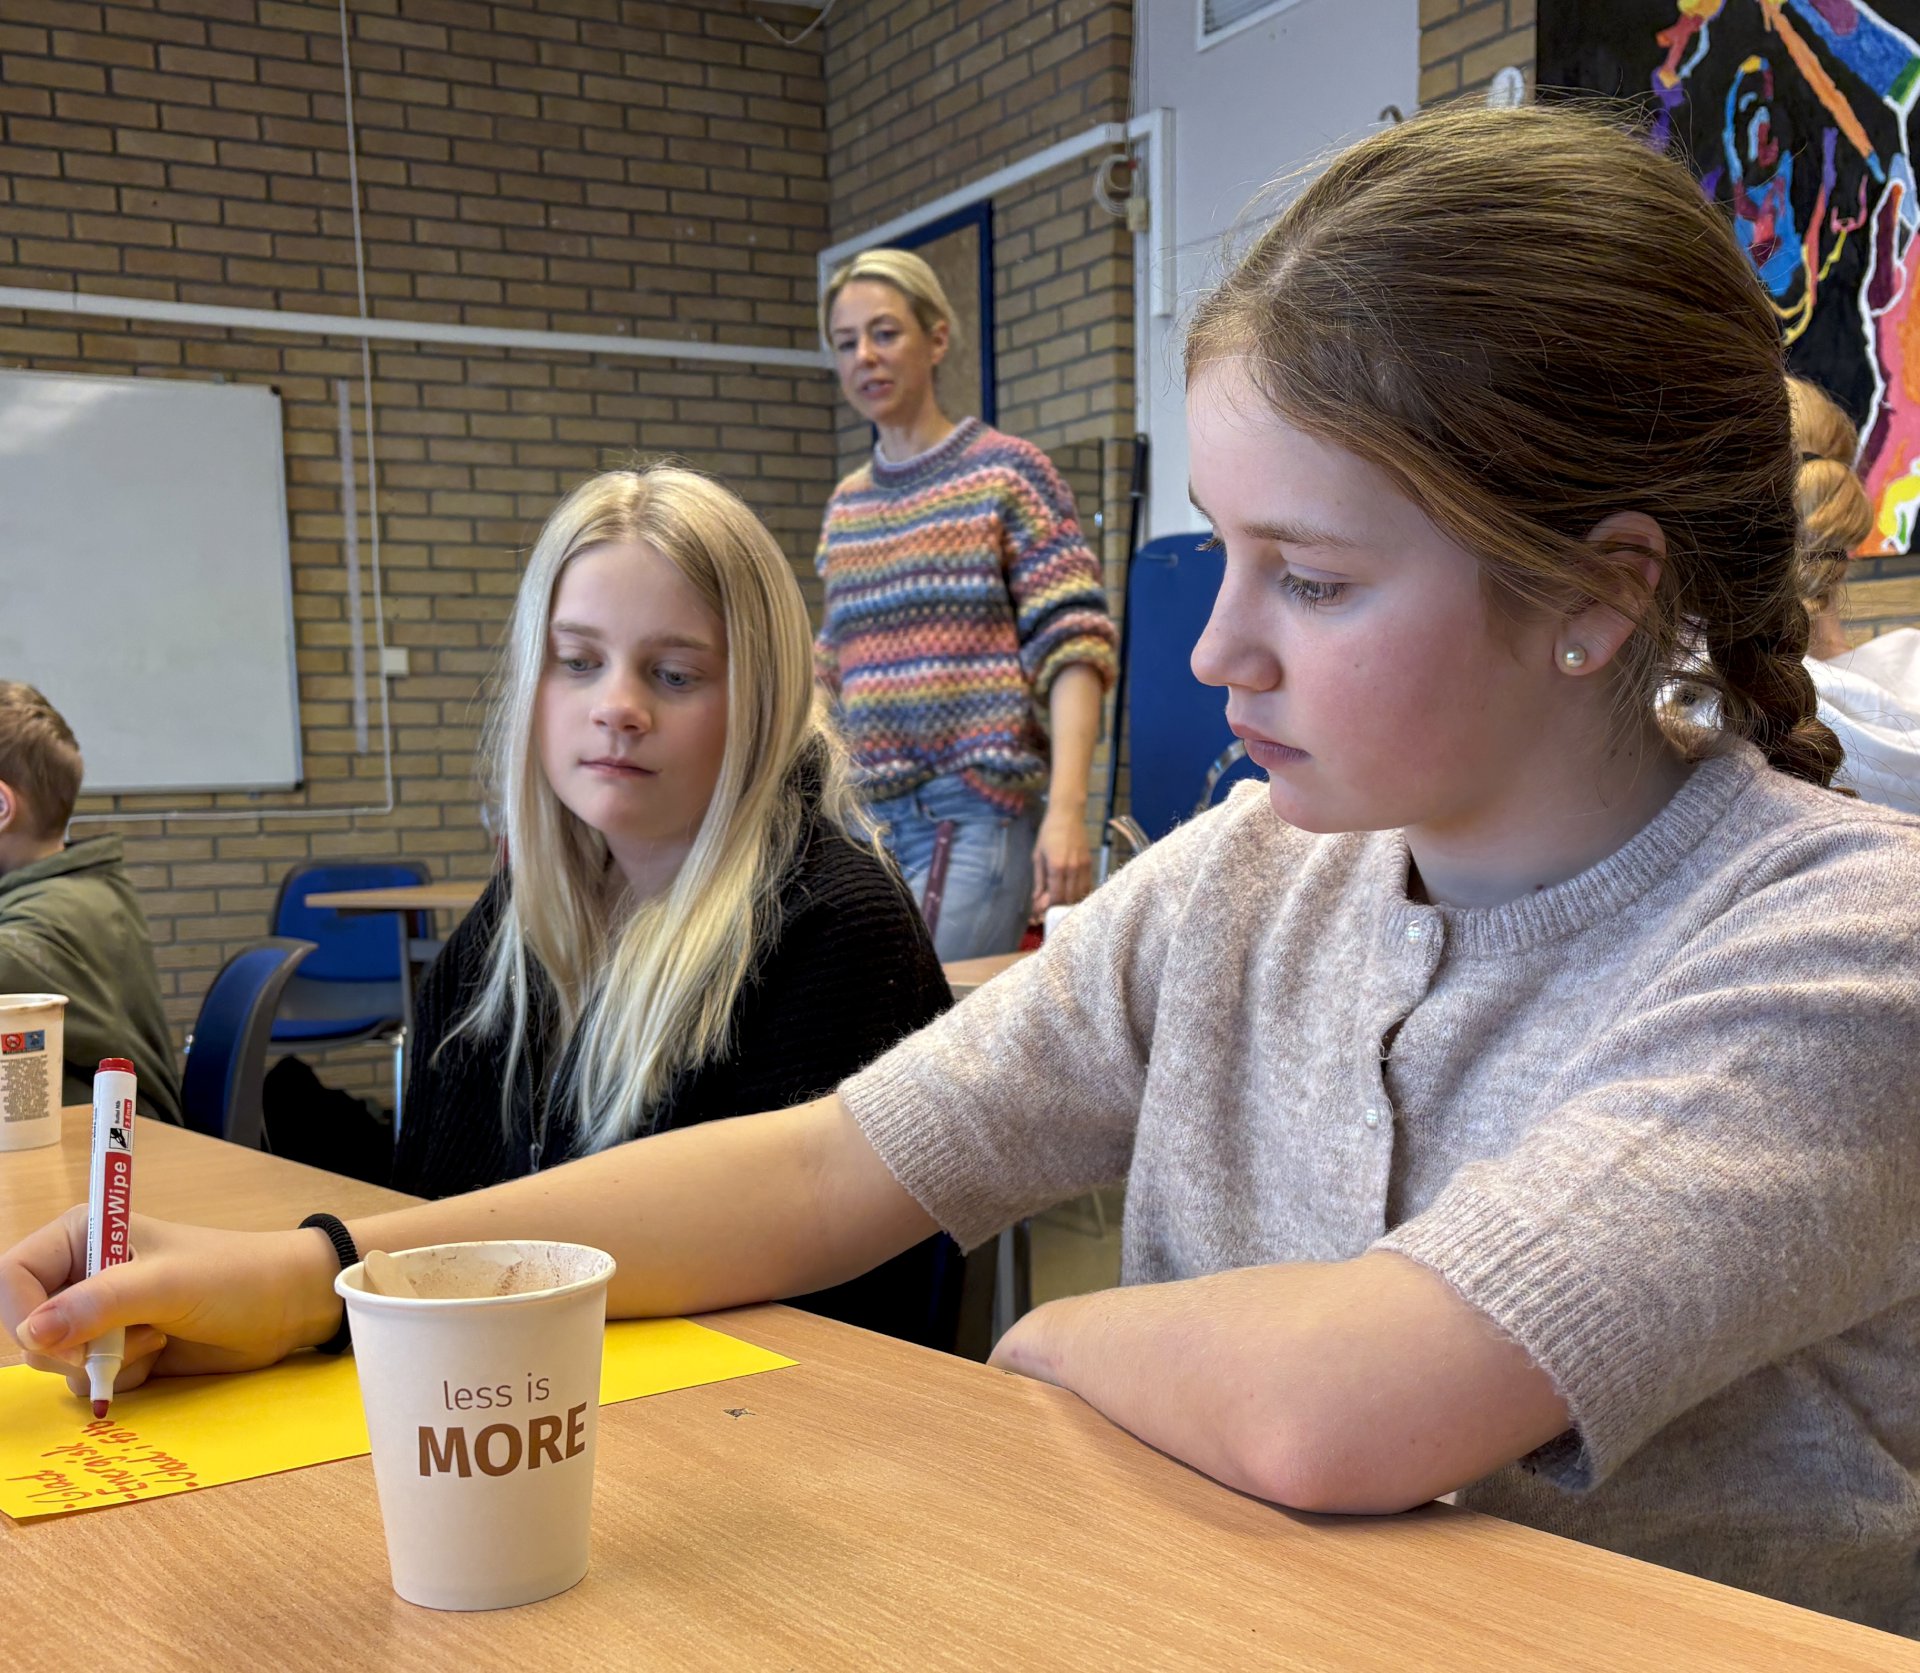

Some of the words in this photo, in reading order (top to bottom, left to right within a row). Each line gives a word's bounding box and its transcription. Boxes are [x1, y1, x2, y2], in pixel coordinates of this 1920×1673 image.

[105, 1161, 129, 1269] EasyWipe
[443, 1380, 513, 1411] less
[526, 1372, 550, 1403] is
[418, 1401, 588, 1478] MORE
[5, 1469, 93, 1504] Glad
